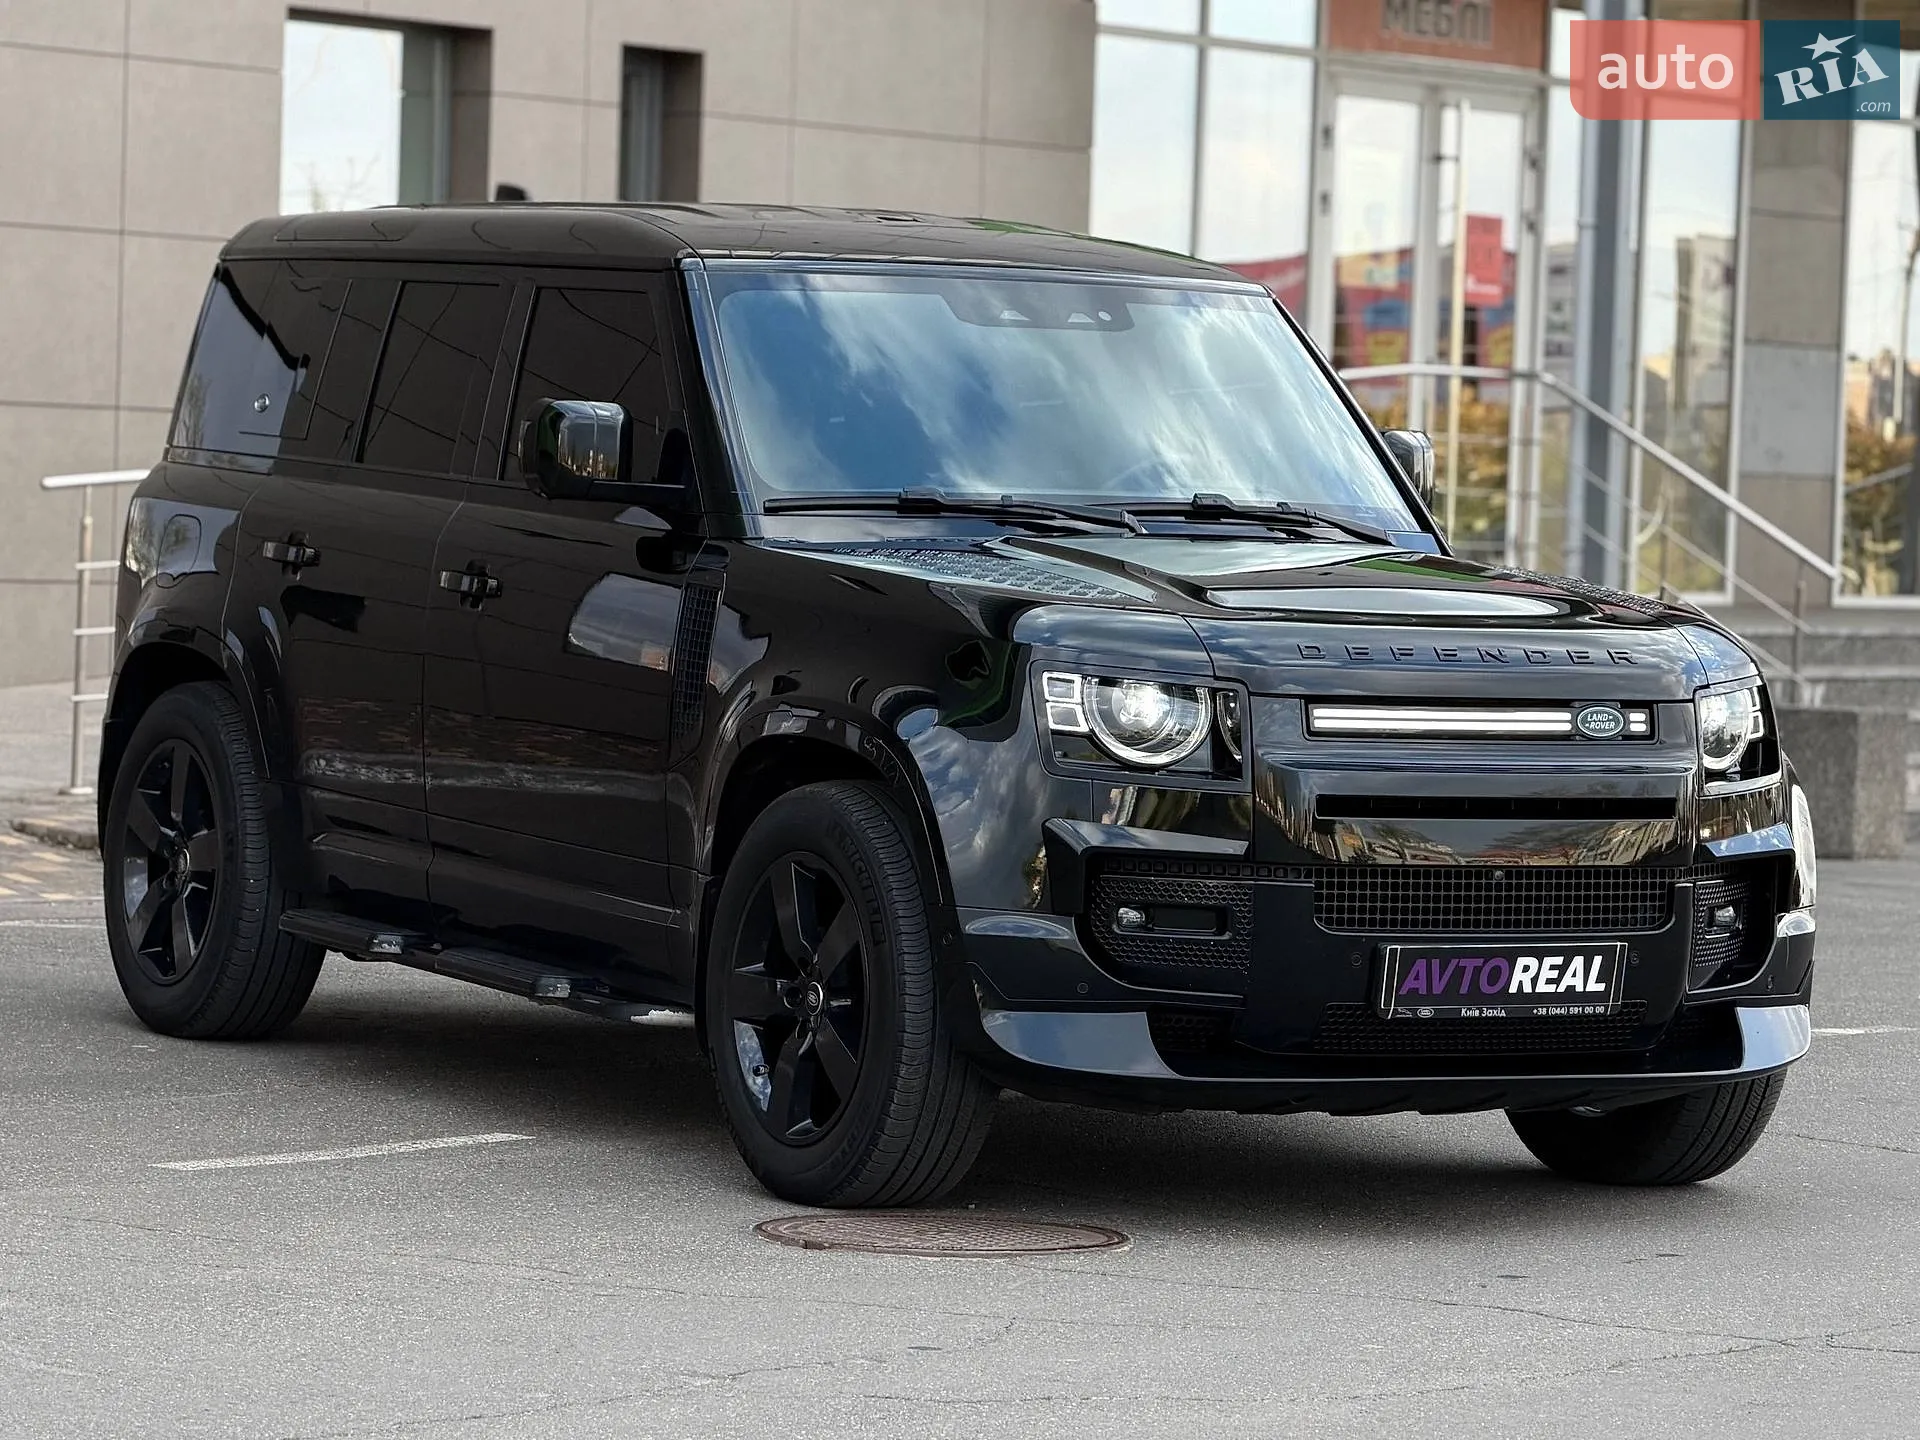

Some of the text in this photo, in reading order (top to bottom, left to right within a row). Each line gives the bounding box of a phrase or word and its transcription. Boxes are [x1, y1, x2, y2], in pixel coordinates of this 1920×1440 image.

[1297, 643, 1639, 665] DEFENDER
[1399, 956, 1606, 995] AVTOREAL
[1461, 1007, 1480, 1017] Київ
[1532, 1005, 1605, 1015] +38 (044) 591 00 00
